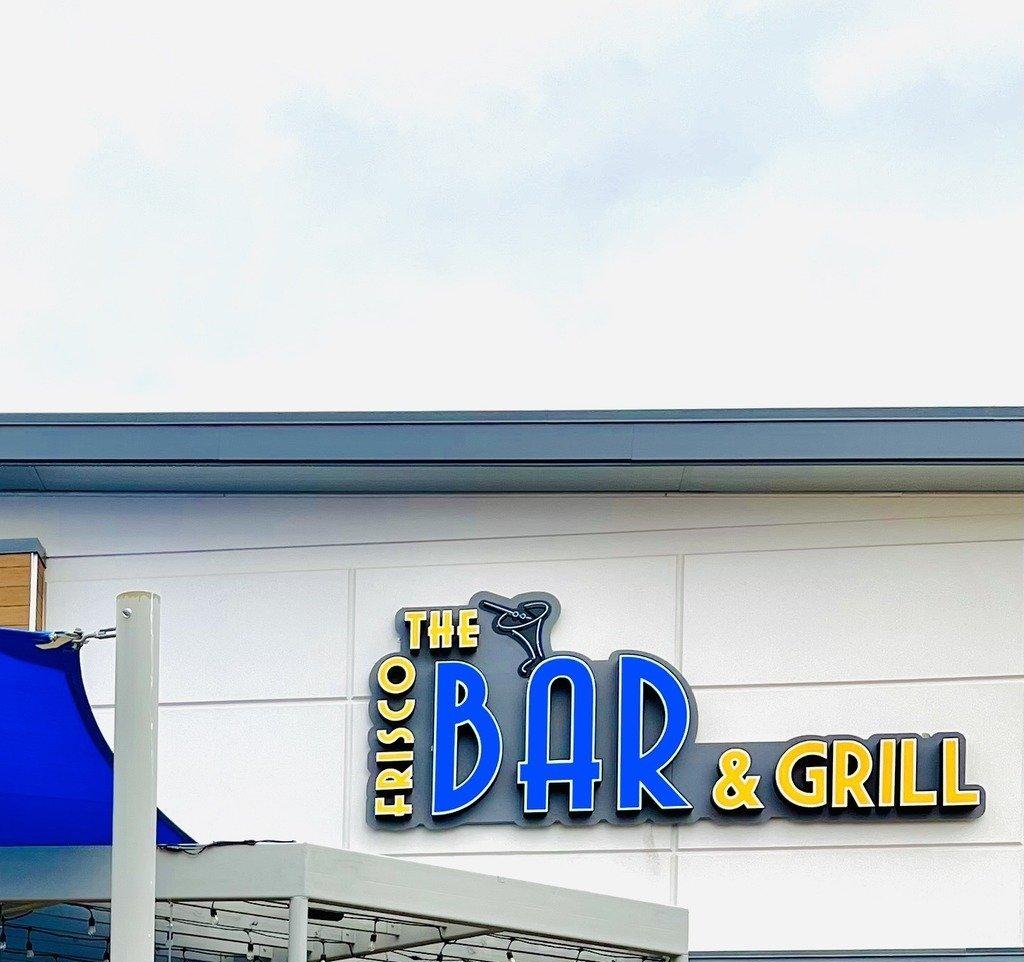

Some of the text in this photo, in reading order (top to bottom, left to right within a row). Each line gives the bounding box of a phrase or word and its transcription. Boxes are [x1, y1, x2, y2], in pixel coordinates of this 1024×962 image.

[405, 610, 480, 648] THE
[376, 656, 416, 817] FRISCO
[432, 654, 692, 814] BAR
[712, 738, 980, 810] & GRILL
